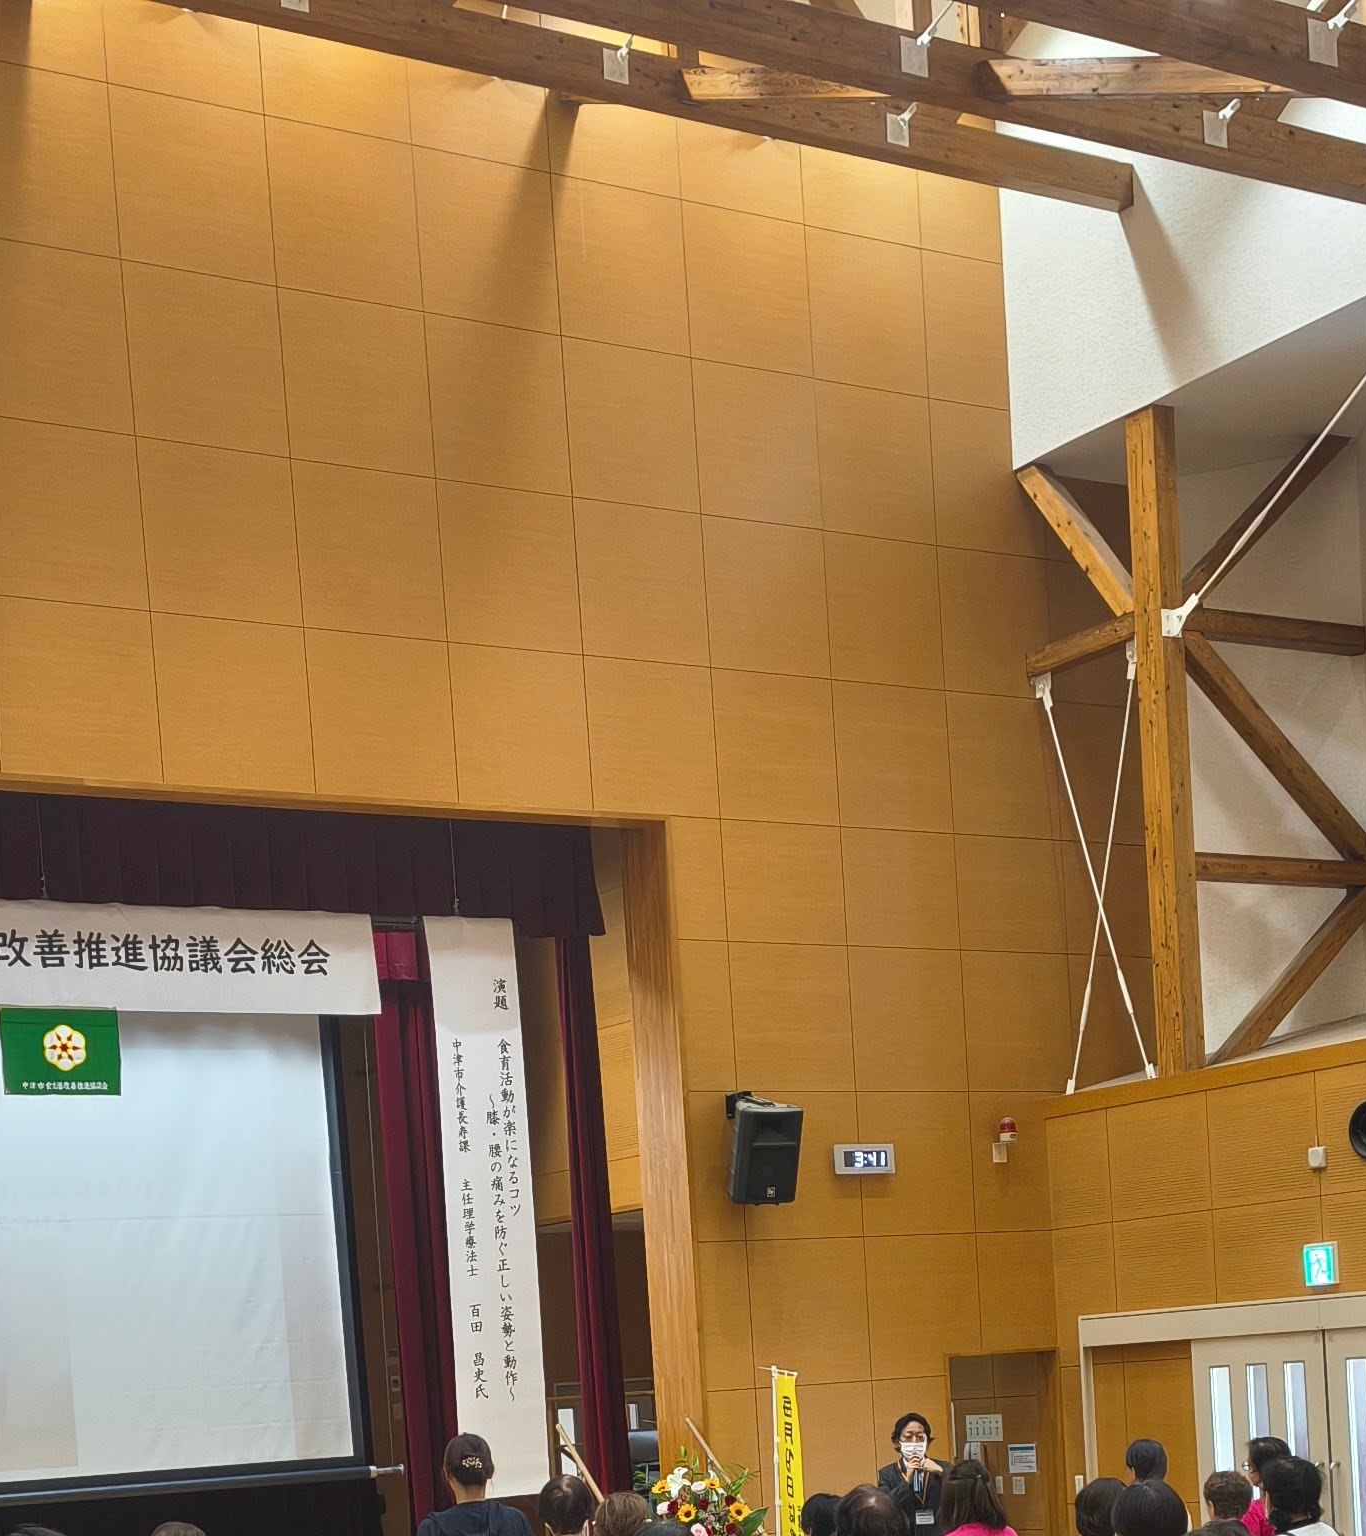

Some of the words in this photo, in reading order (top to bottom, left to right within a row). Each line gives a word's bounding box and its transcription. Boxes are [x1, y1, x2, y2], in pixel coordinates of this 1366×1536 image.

[492, 978, 509, 1010] 演題
[497, 1038, 521, 1216] 食育活動が楽になるコツ
[460, 1178, 479, 1277] 主任理学療法士
